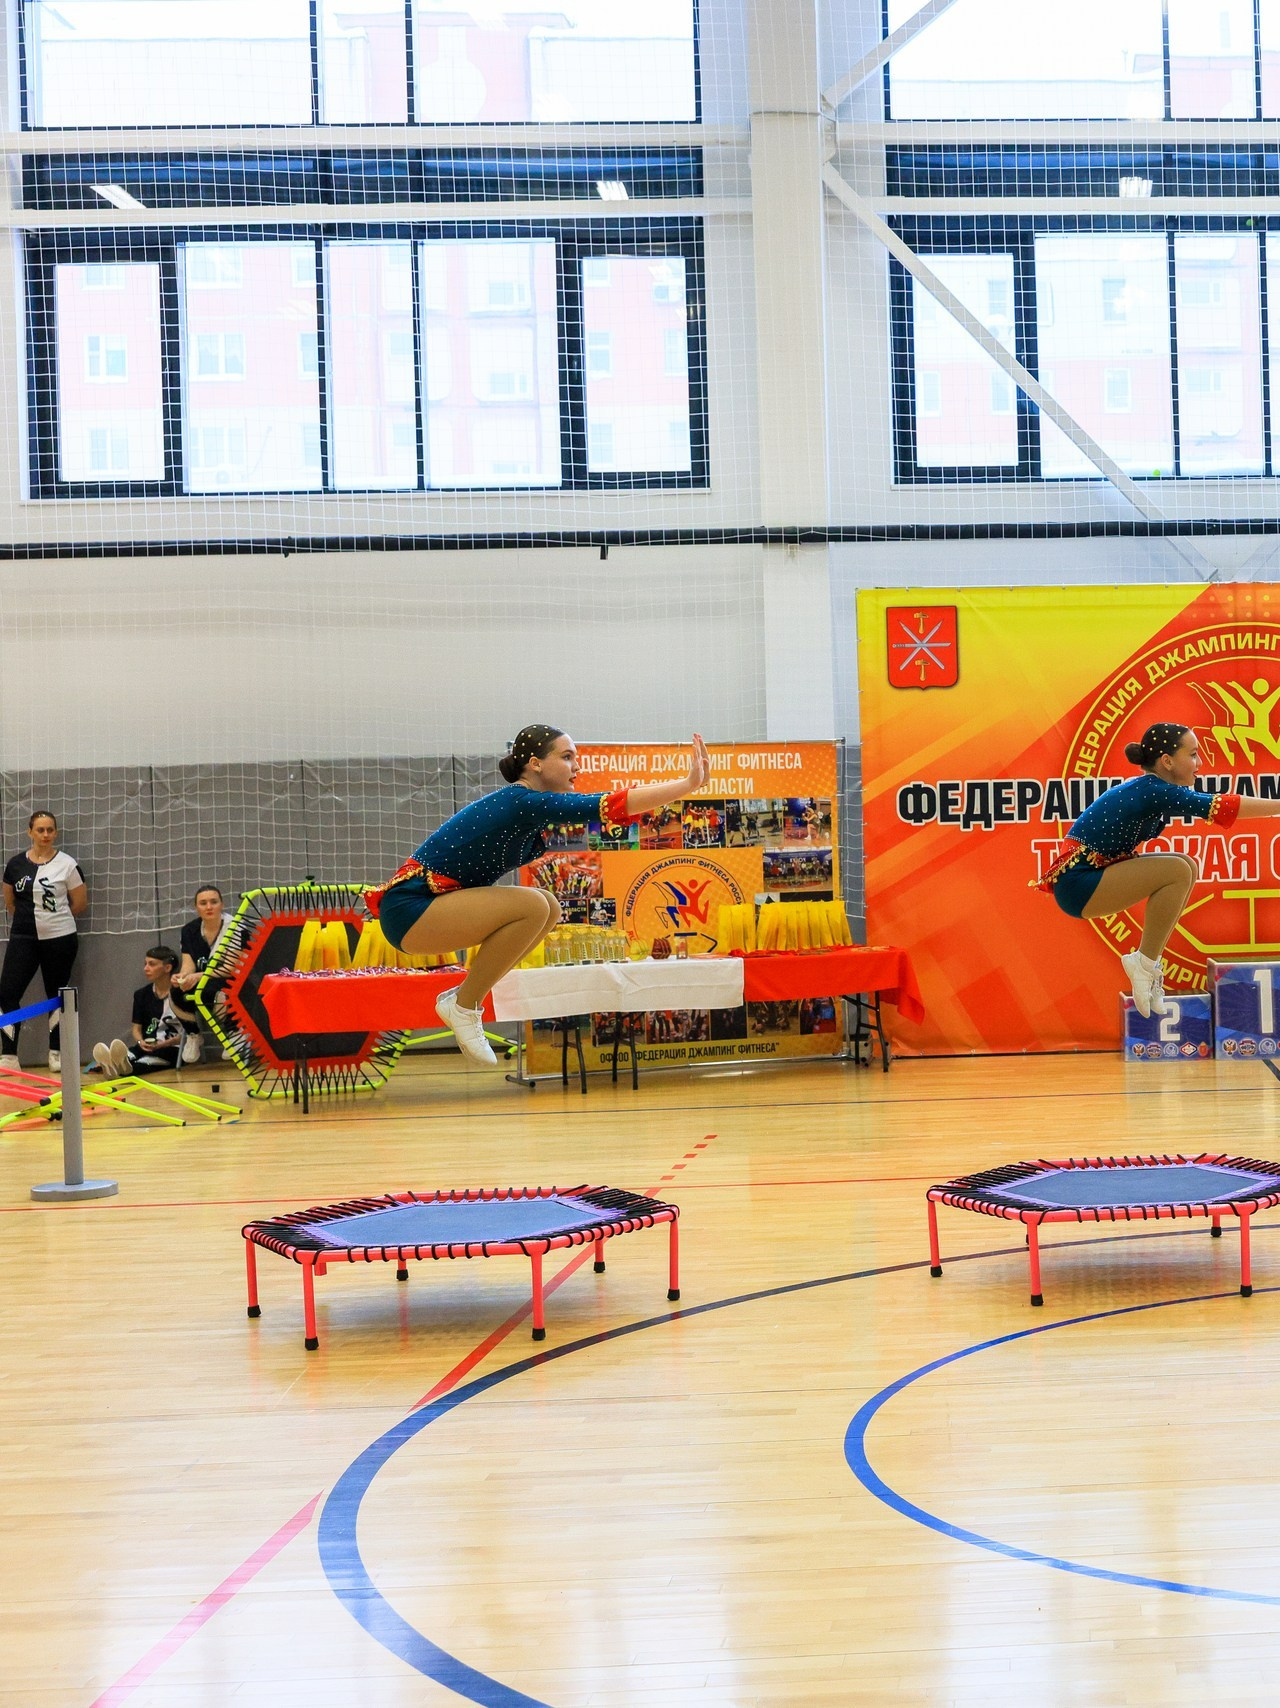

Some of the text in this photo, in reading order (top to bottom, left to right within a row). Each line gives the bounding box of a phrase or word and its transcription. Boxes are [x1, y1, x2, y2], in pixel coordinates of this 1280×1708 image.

[1074, 676, 1143, 778] ДЕРАЦИЯ
[577, 753, 647, 773] ДЕРАЦИЯ
[737, 752, 803, 770] ФИТНЕСА
[626, 872, 650, 917] ФЕДЕРАЦИЯ
[651, 858, 696, 874] ДЖАМПИНГ
[698, 860, 729, 883] ФИТНЕСА
[1159, 1001, 1181, 1041] 2
[1253, 969, 1274, 1033] 1
[600, 1052, 629, 1063] ОФОО
[688, 1045, 737, 1059] ДЖАМПИНГ
[737, 1042, 780, 1054] ФИТНЕСА"
